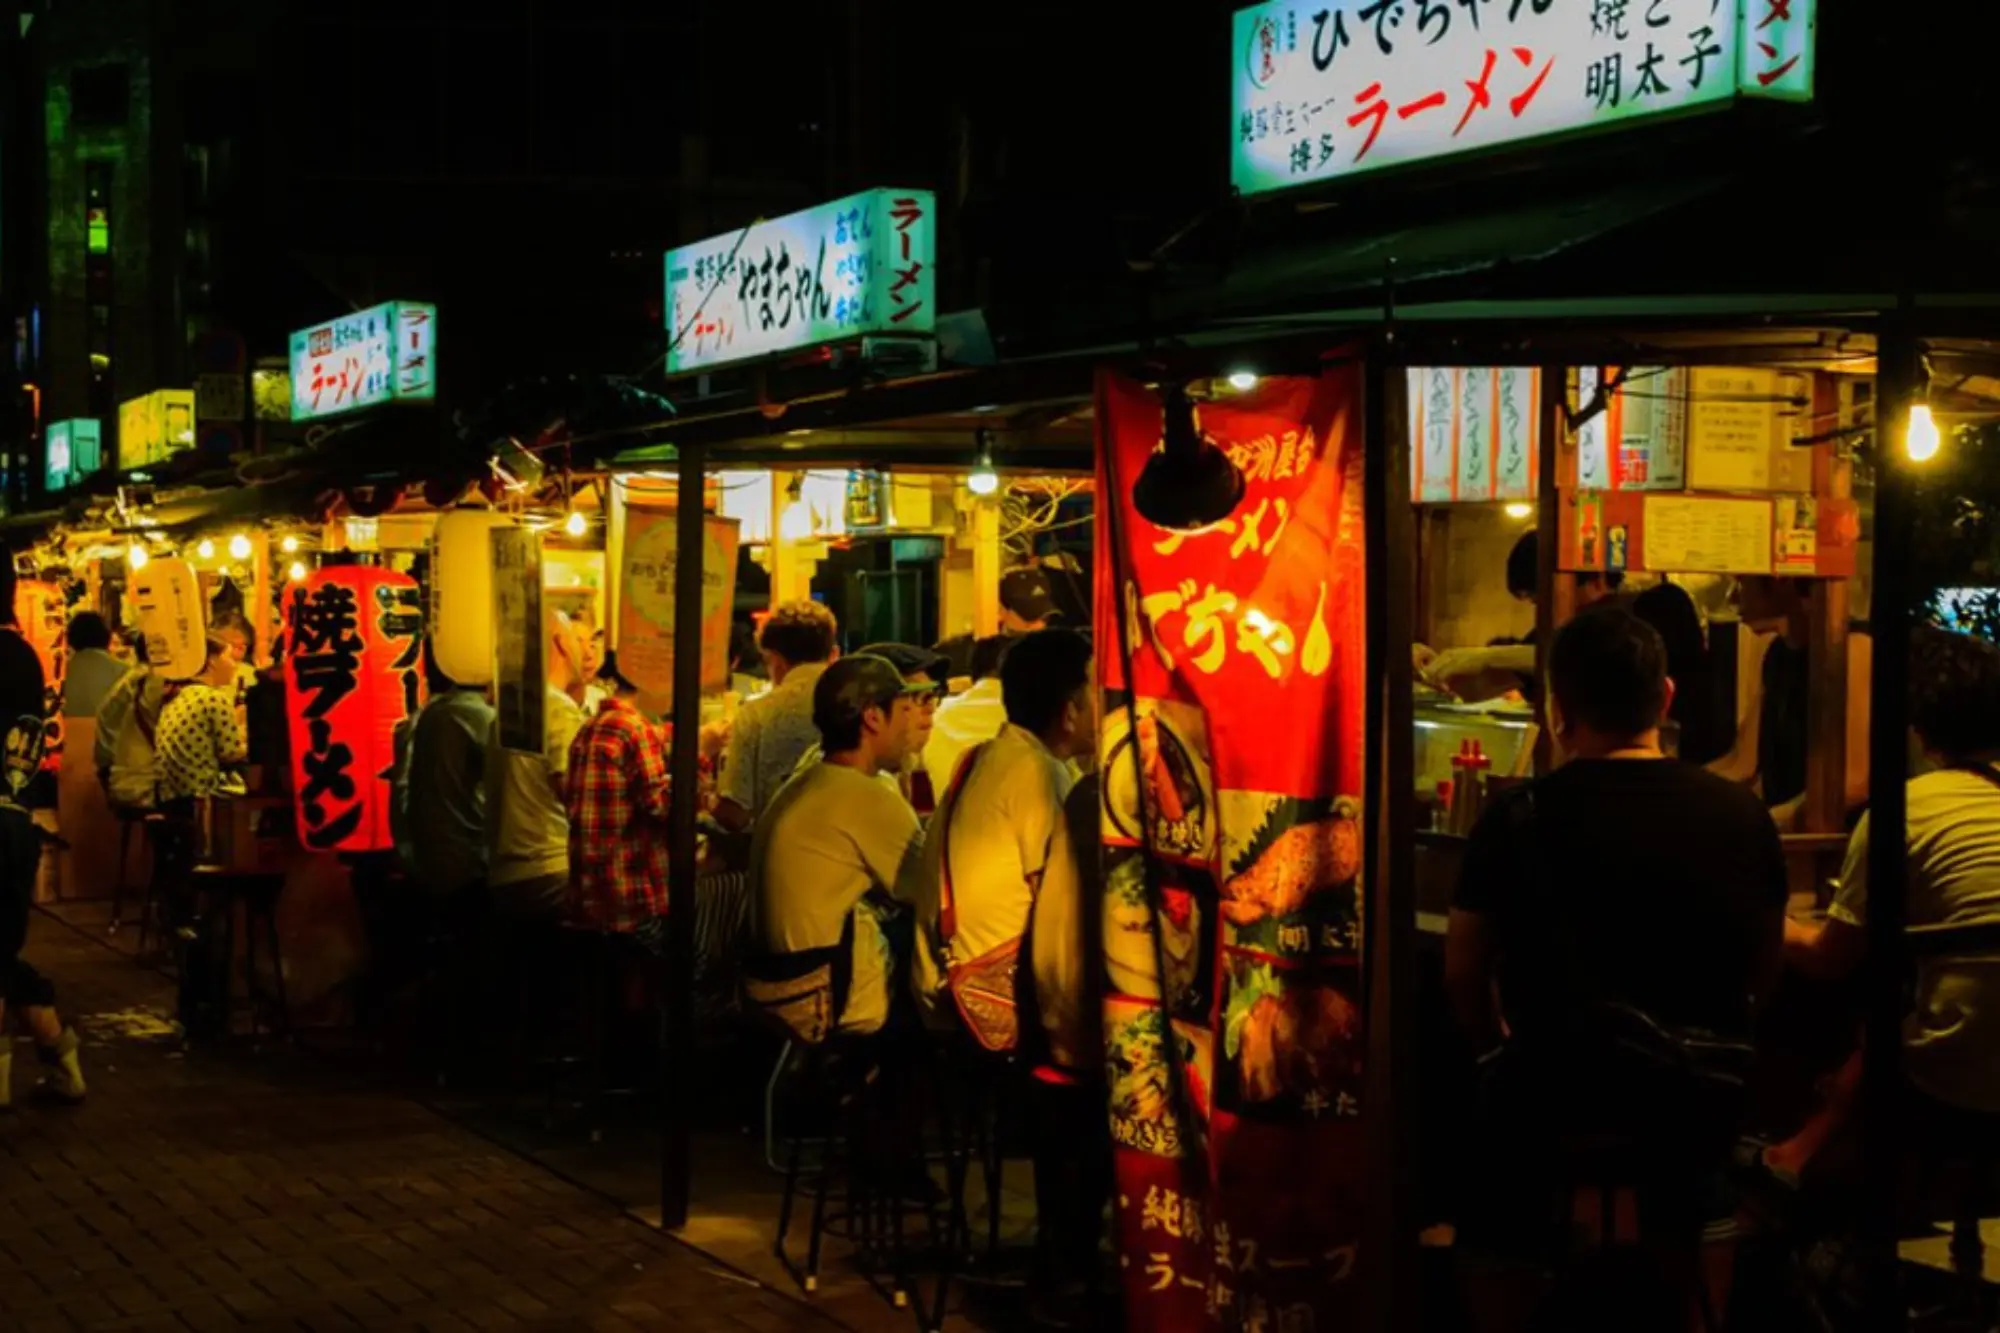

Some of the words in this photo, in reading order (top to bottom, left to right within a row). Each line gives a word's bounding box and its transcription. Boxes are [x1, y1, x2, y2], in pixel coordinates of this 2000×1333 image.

[1346, 48, 1555, 163] ラーメン
[1586, 25, 1721, 108] 明太子
[738, 236, 832, 331] やまちゃん
[890, 198, 923, 323] ラーメン
[310, 357, 366, 410] ラーメン
[288, 582, 364, 849] 焼ラーメン
